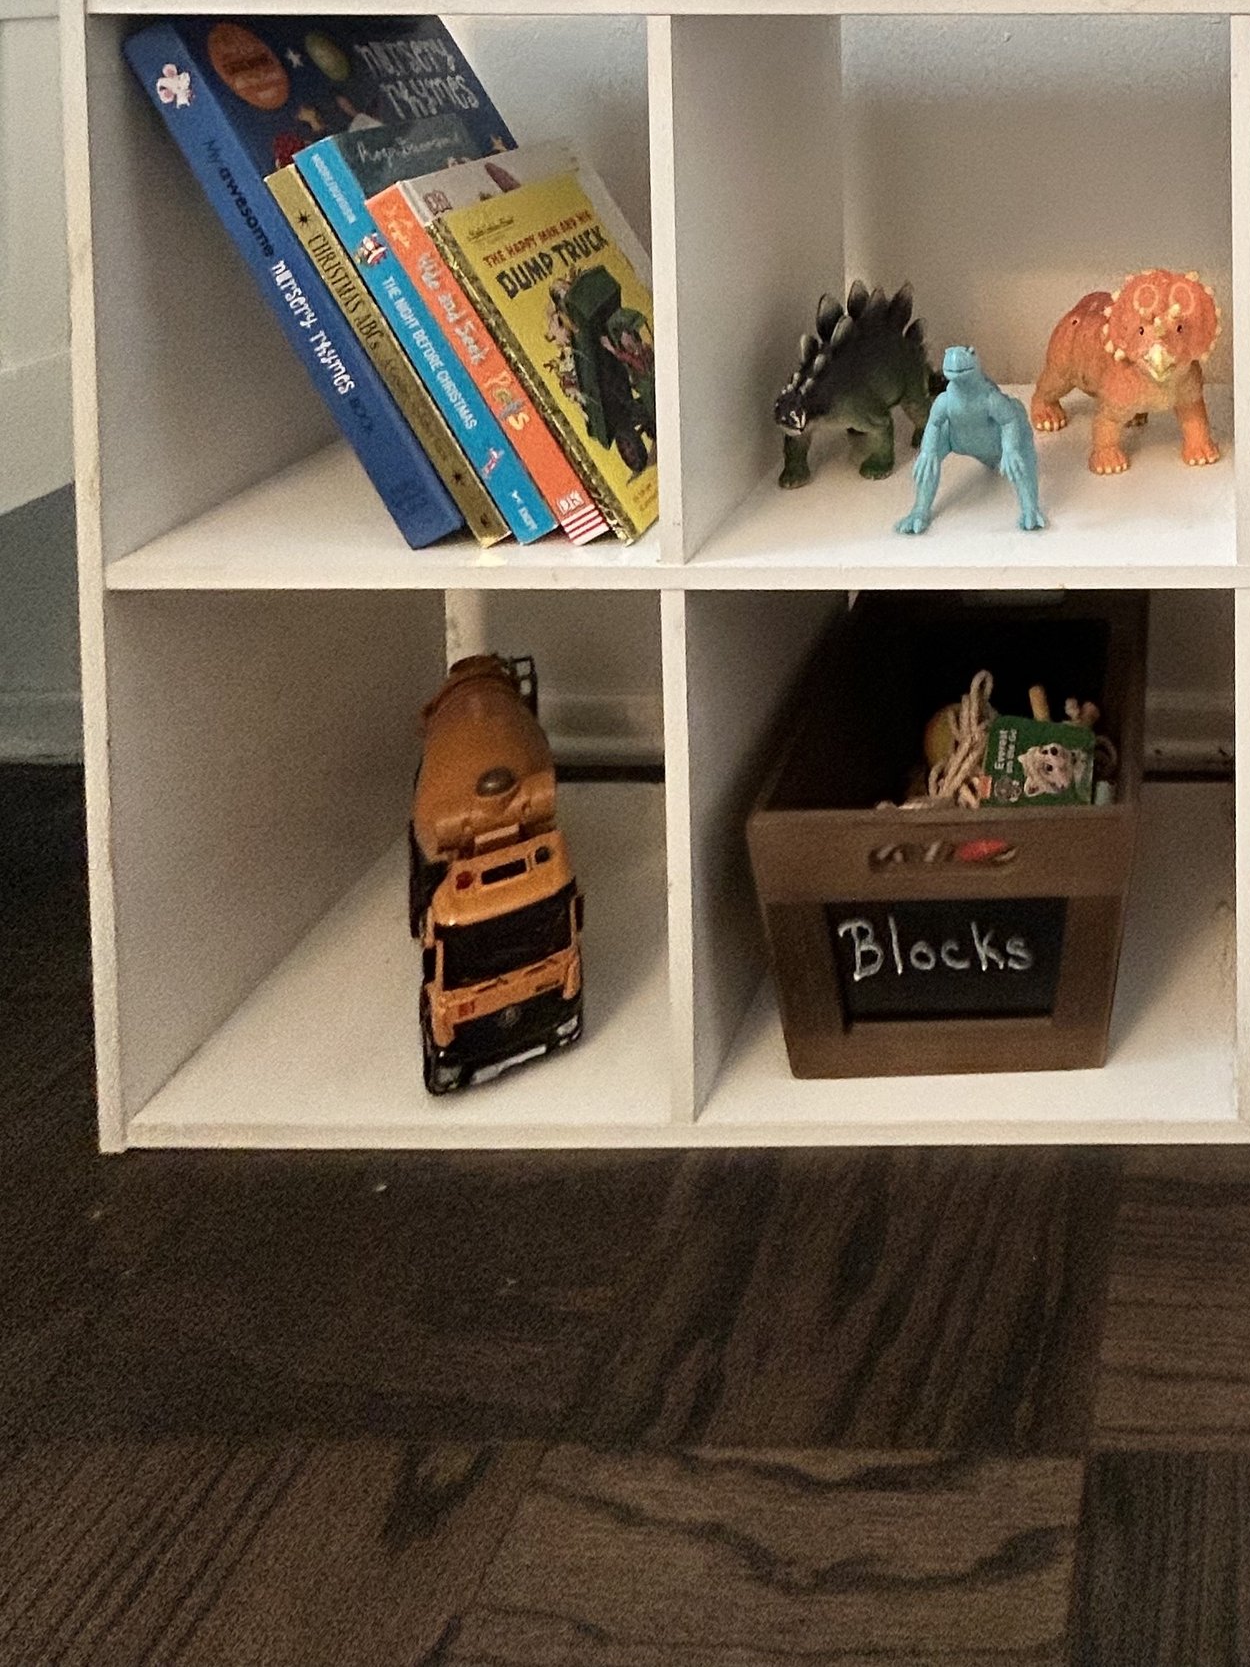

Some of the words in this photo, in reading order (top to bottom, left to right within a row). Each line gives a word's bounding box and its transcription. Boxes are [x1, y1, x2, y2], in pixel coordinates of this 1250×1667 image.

[219, 166, 275, 258] awesome
[272, 259, 318, 329] nursery
[309, 330, 355, 395] rhymes
[307, 233, 366, 315] CHRISTMAS
[482, 249, 507, 267] THE
[496, 252, 554, 299] DUMP
[551, 225, 609, 267] TRUCK
[382, 276, 403, 299] THE
[394, 297, 421, 329] NIGHT
[412, 328, 445, 372] BEFORE
[436, 370, 478, 430] CHRISTMAS
[838, 915, 1035, 982] Blocks
